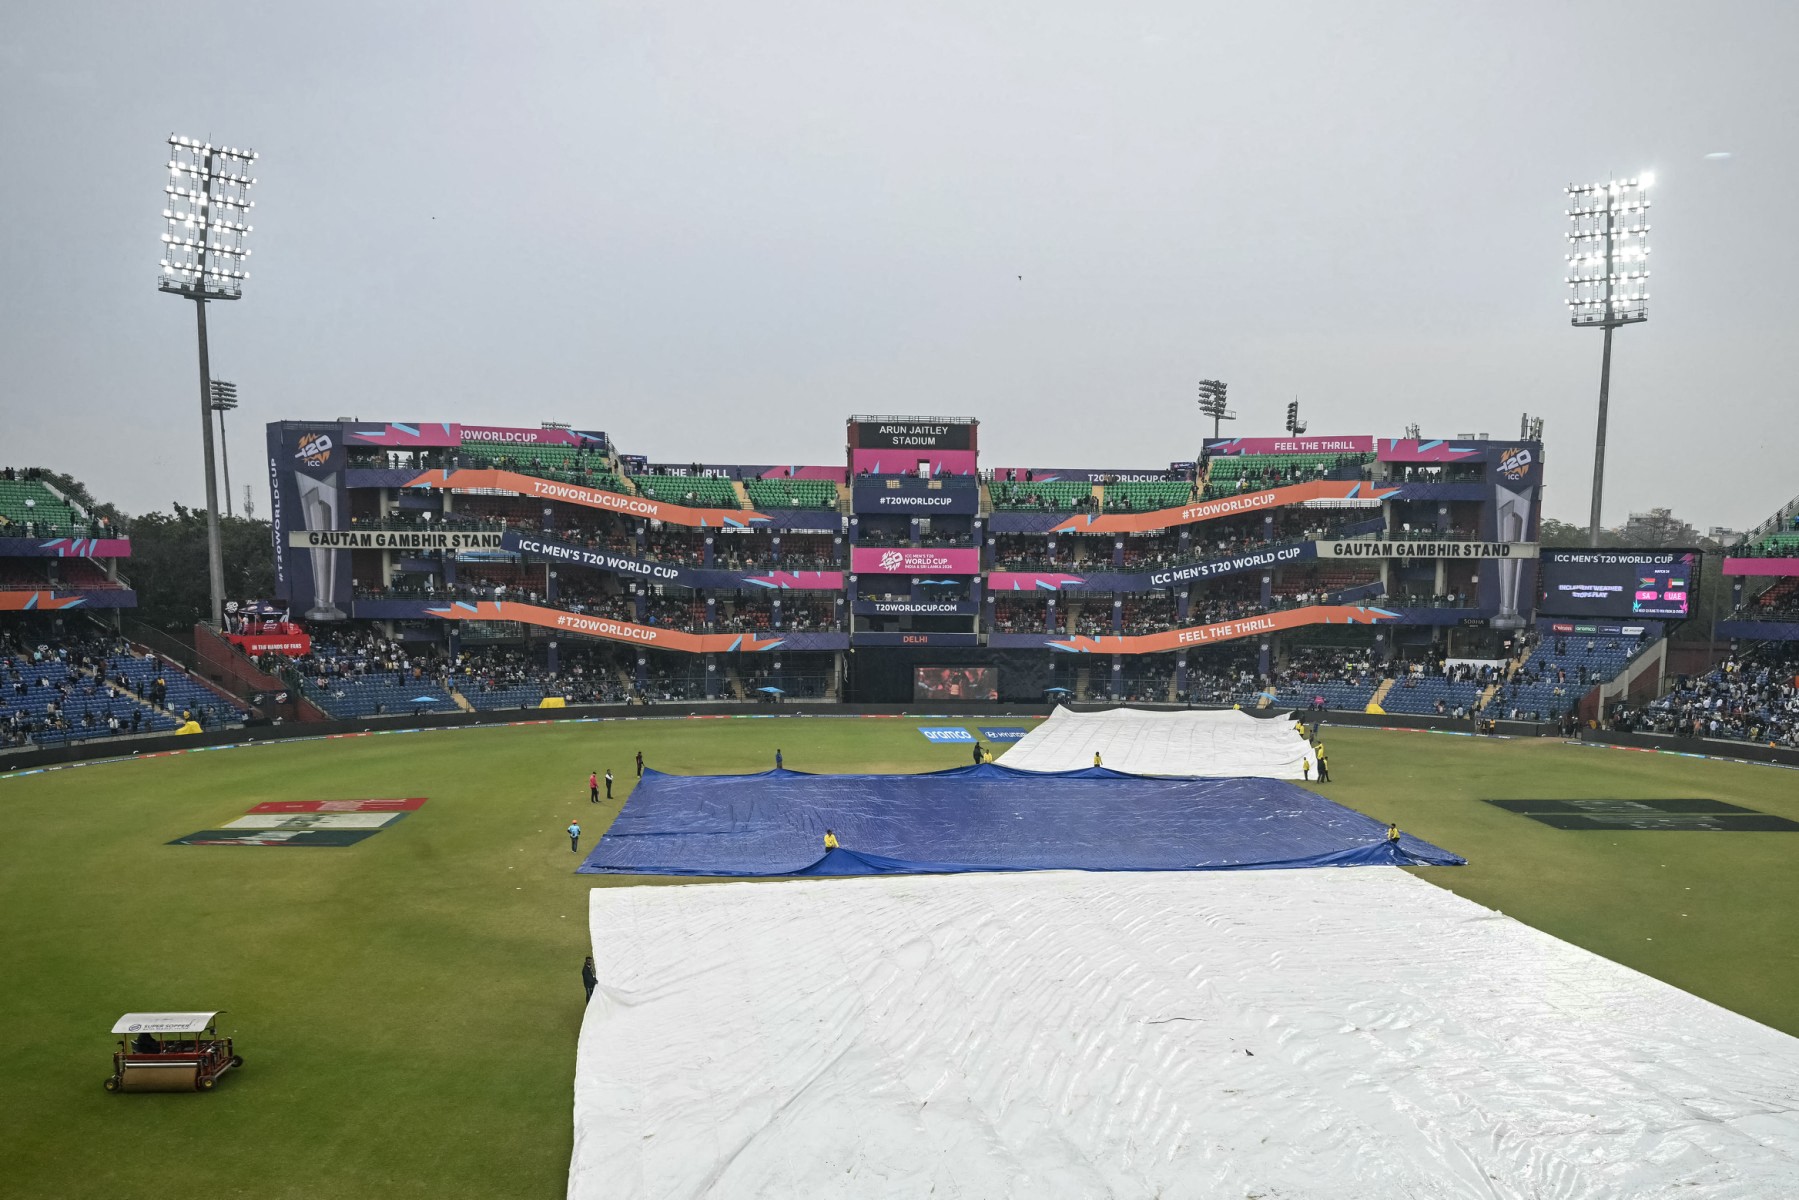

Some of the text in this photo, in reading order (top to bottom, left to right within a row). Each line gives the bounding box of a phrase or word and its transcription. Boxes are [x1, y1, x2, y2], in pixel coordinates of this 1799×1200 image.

[879, 425, 949, 435] ARUN JAITLEY
[892, 436, 936, 445] STADIUM
[1274, 441, 1355, 451] FEEL THE THRILL
[534, 481, 659, 515] T20WORLDCUP.COM
[879, 497, 952, 505] #T20WORLDCUP
[1182, 493, 1275, 520] #T20WORLDCUP
[271, 458, 283, 582] #T20WORLDCUP
[309, 531, 501, 548] GAUTAM GAMBHIR STAND
[1333, 543, 1510, 557] GAUTAM GAMBHIR STAND
[518, 539, 679, 579] ICC MEN'S T20 WORLD CUP
[1150, 547, 1300, 585] ICC MEN'S T20 WORLD CUP
[1554, 554, 1674, 564] ICC MEN'S T20 WORLD CUP
[875, 603, 957, 612] T20WORLDCUP.COM
[557, 615, 657, 640] #T20WORLDCUP
[1178, 618, 1275, 643] FEEL THE THRILL
[903, 635, 928, 643] DELHI
[924, 730, 972, 739] aramco
